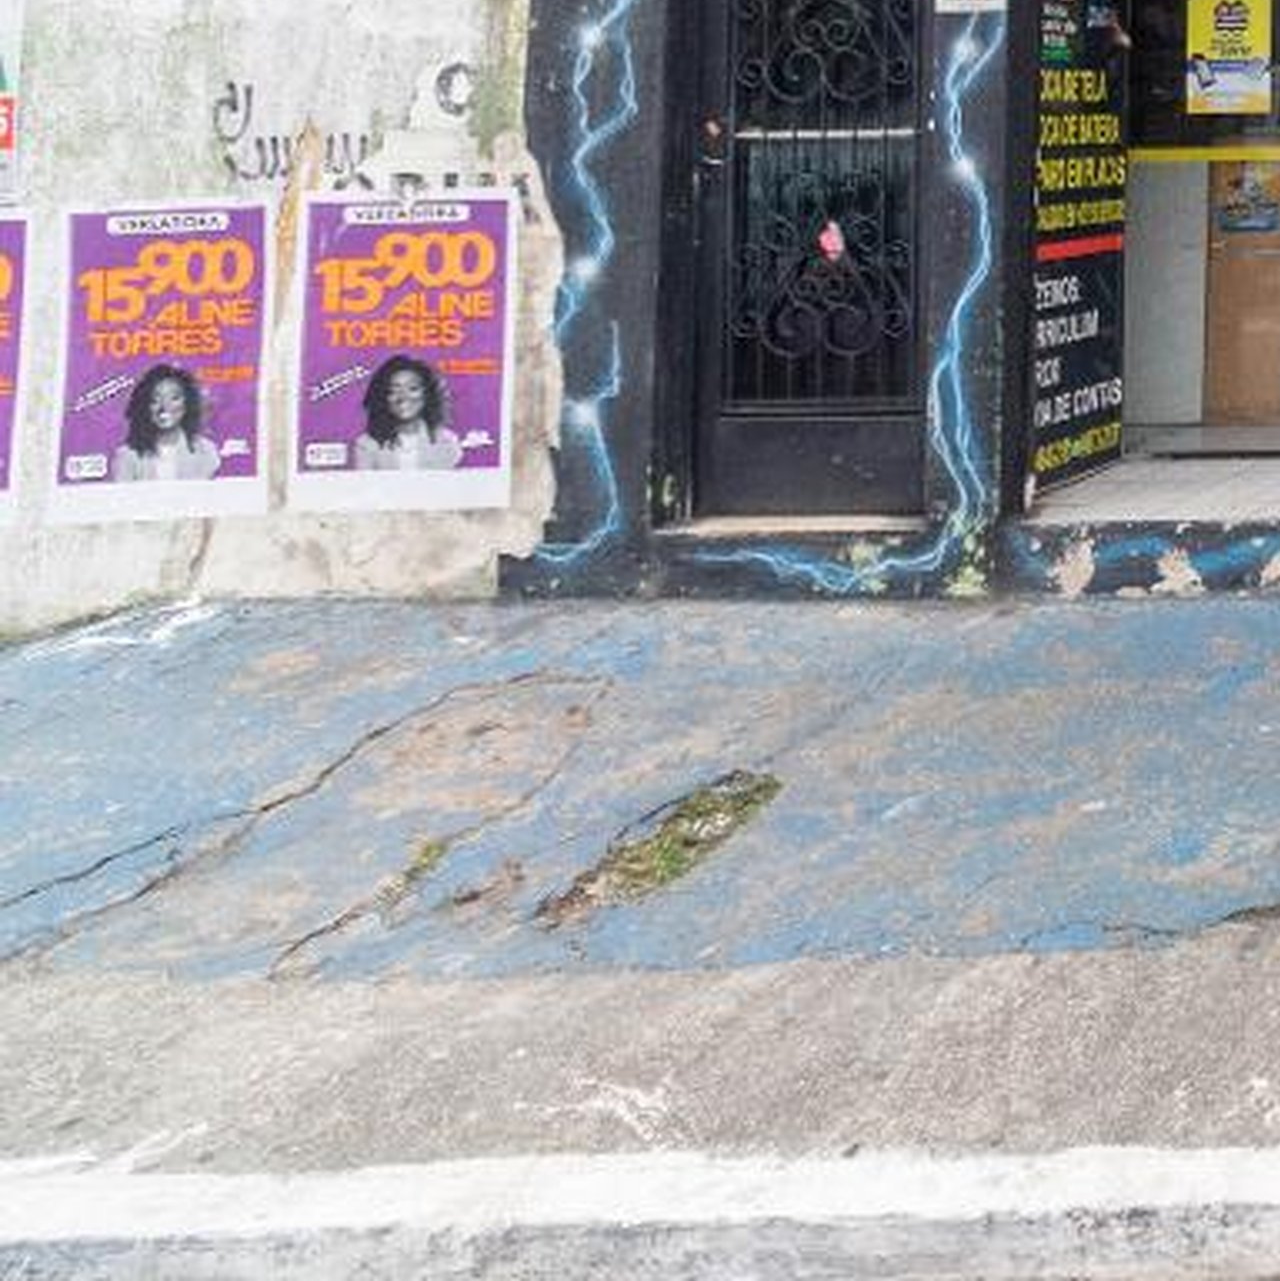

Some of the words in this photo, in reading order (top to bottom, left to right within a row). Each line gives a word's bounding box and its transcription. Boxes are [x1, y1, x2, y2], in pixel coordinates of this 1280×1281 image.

[152, 298, 256, 330] ALINE
[389, 290, 495, 321] ALINE
[90, 327, 223, 358] TORRES
[324, 319, 465, 347] TORRES
